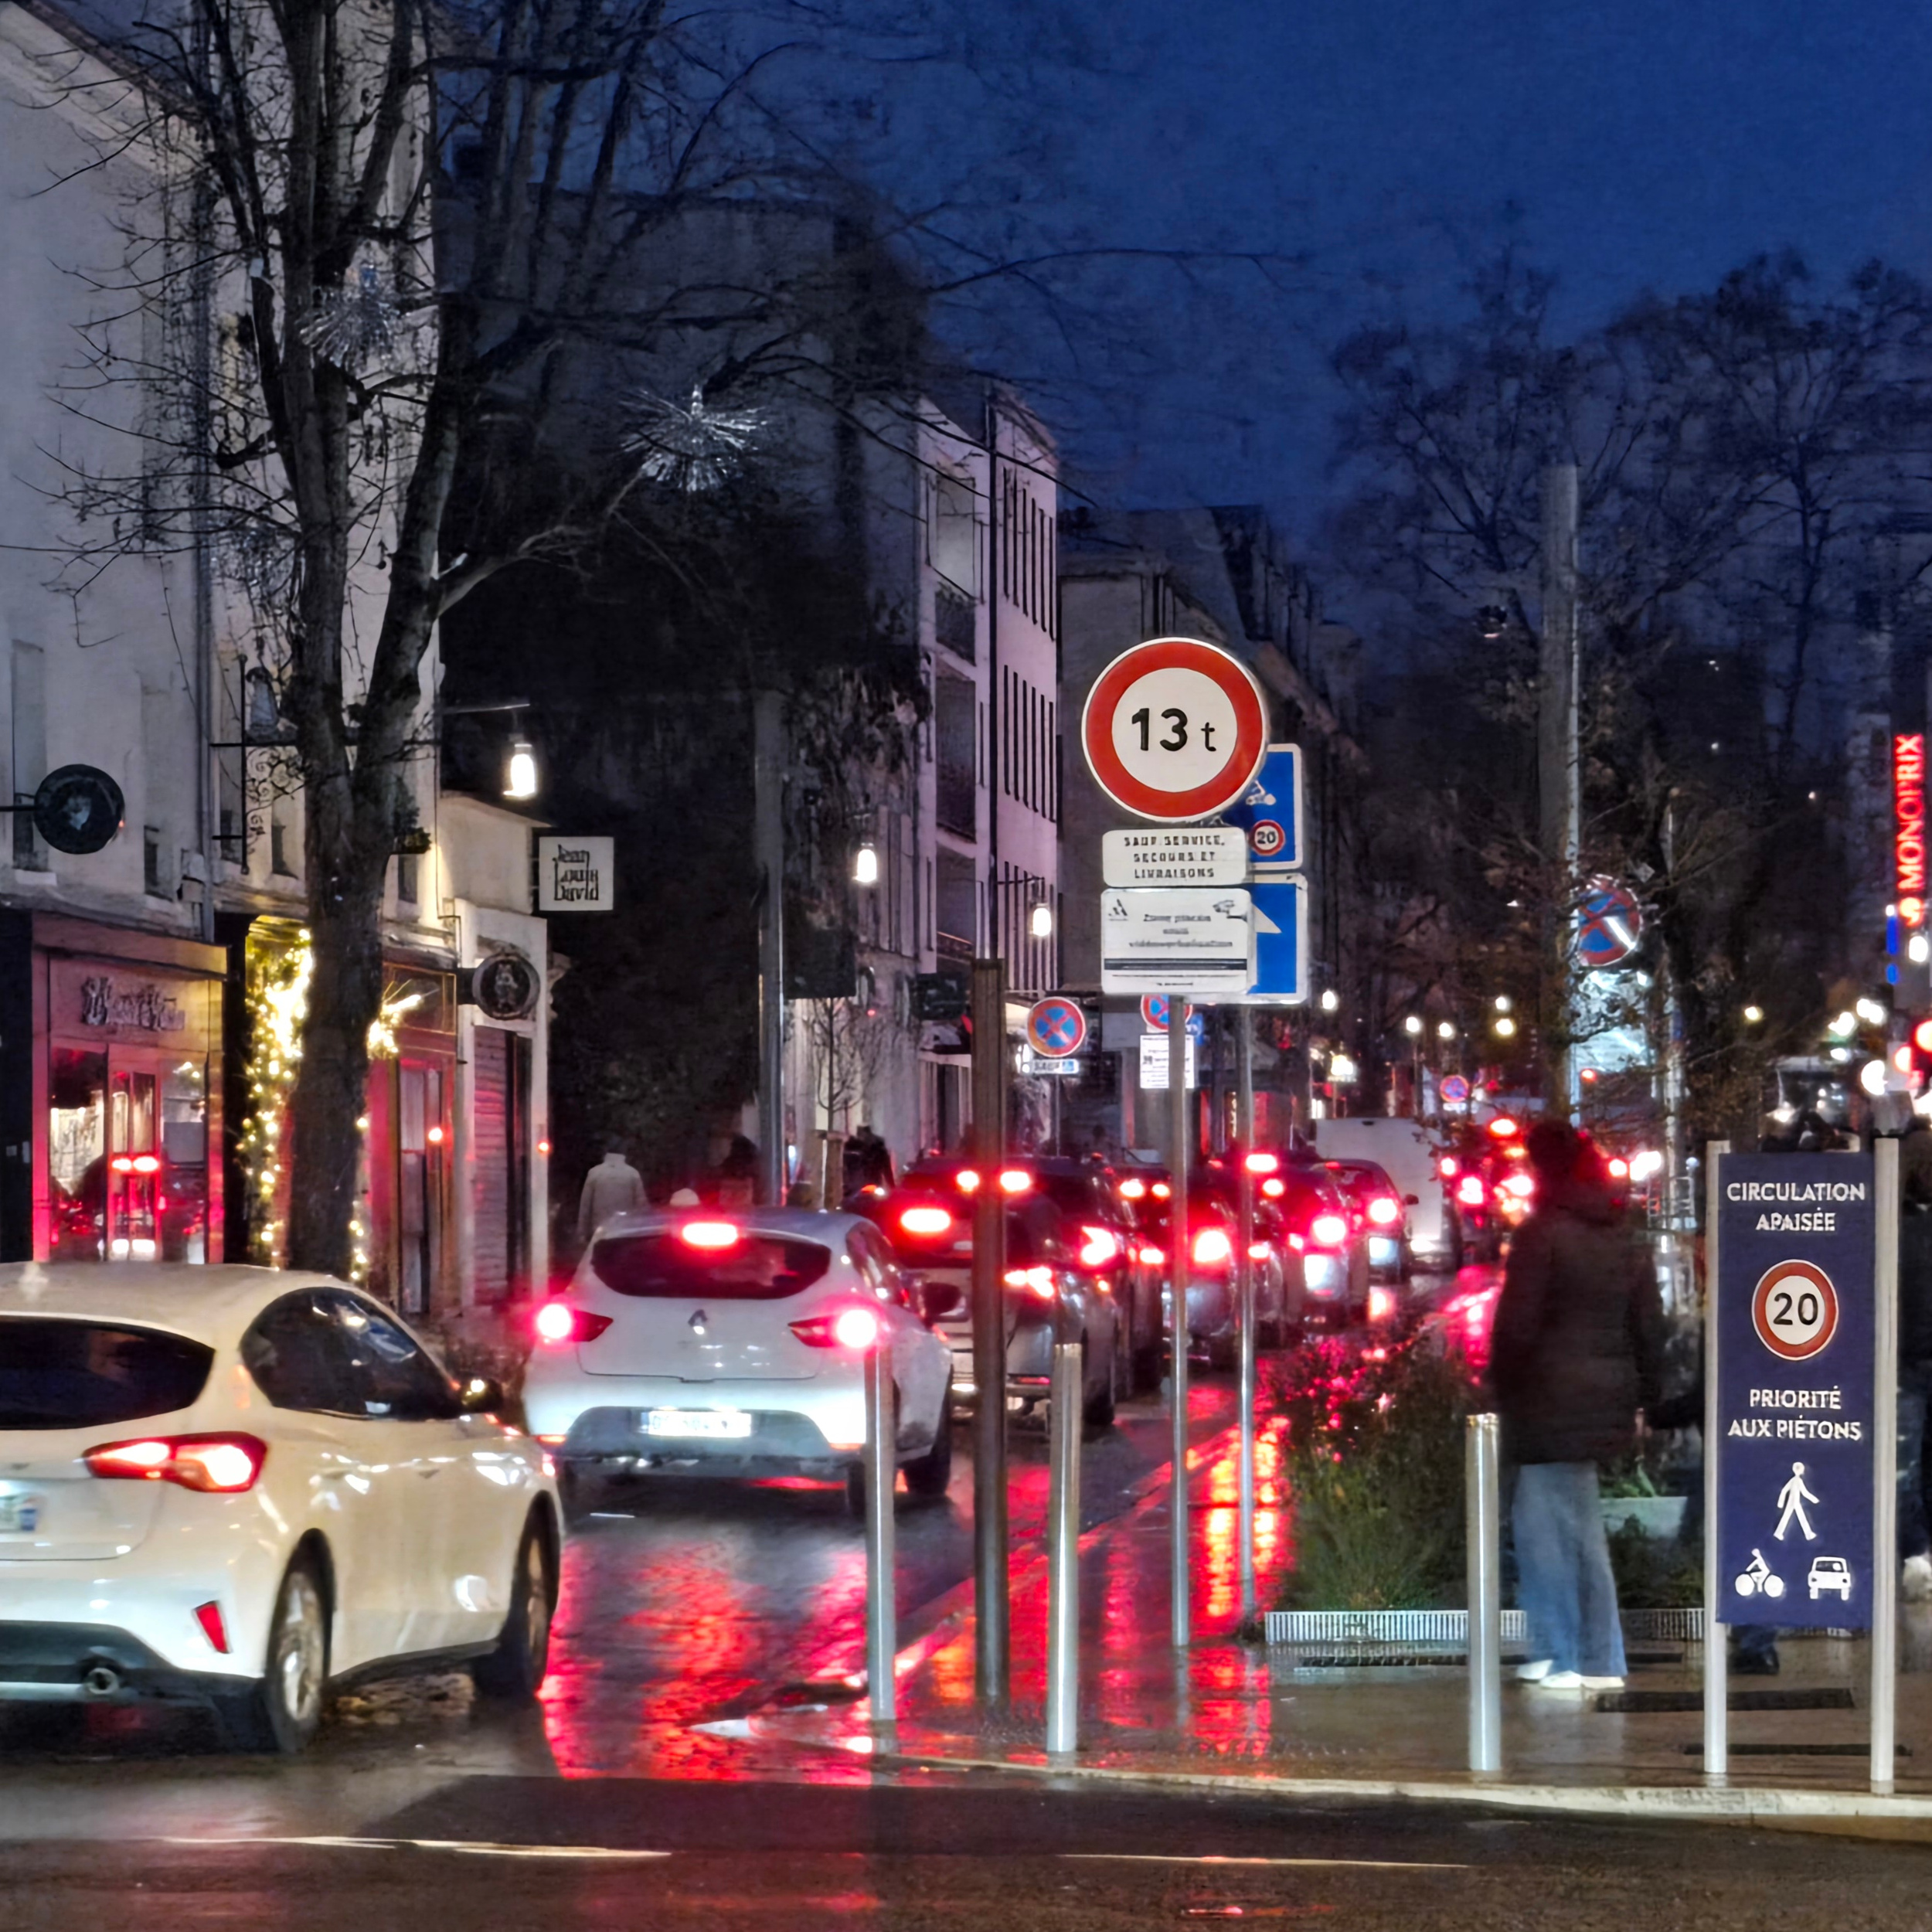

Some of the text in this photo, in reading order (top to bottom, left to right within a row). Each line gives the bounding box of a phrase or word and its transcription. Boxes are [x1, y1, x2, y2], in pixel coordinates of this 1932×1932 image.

[1131, 708, 1217, 752] 13 t
[1896, 734, 1924, 890] MONOPRIX
[1124, 835, 1157, 846] SAUF
[1257, 831, 1277, 844] 20
[1134, 851, 1216, 862] SECOURS ET
[1134, 868, 1215, 879] LIVRAISONS
[1726, 1182, 1866, 1202] CIRCULATION
[1755, 1207, 1836, 1232] APAISÉE
[1773, 1292, 1819, 1325] 20
[1750, 1386, 1842, 1410] PRIORITÉ
[1727, 1414, 1862, 1441] AUX PIÉTONS
